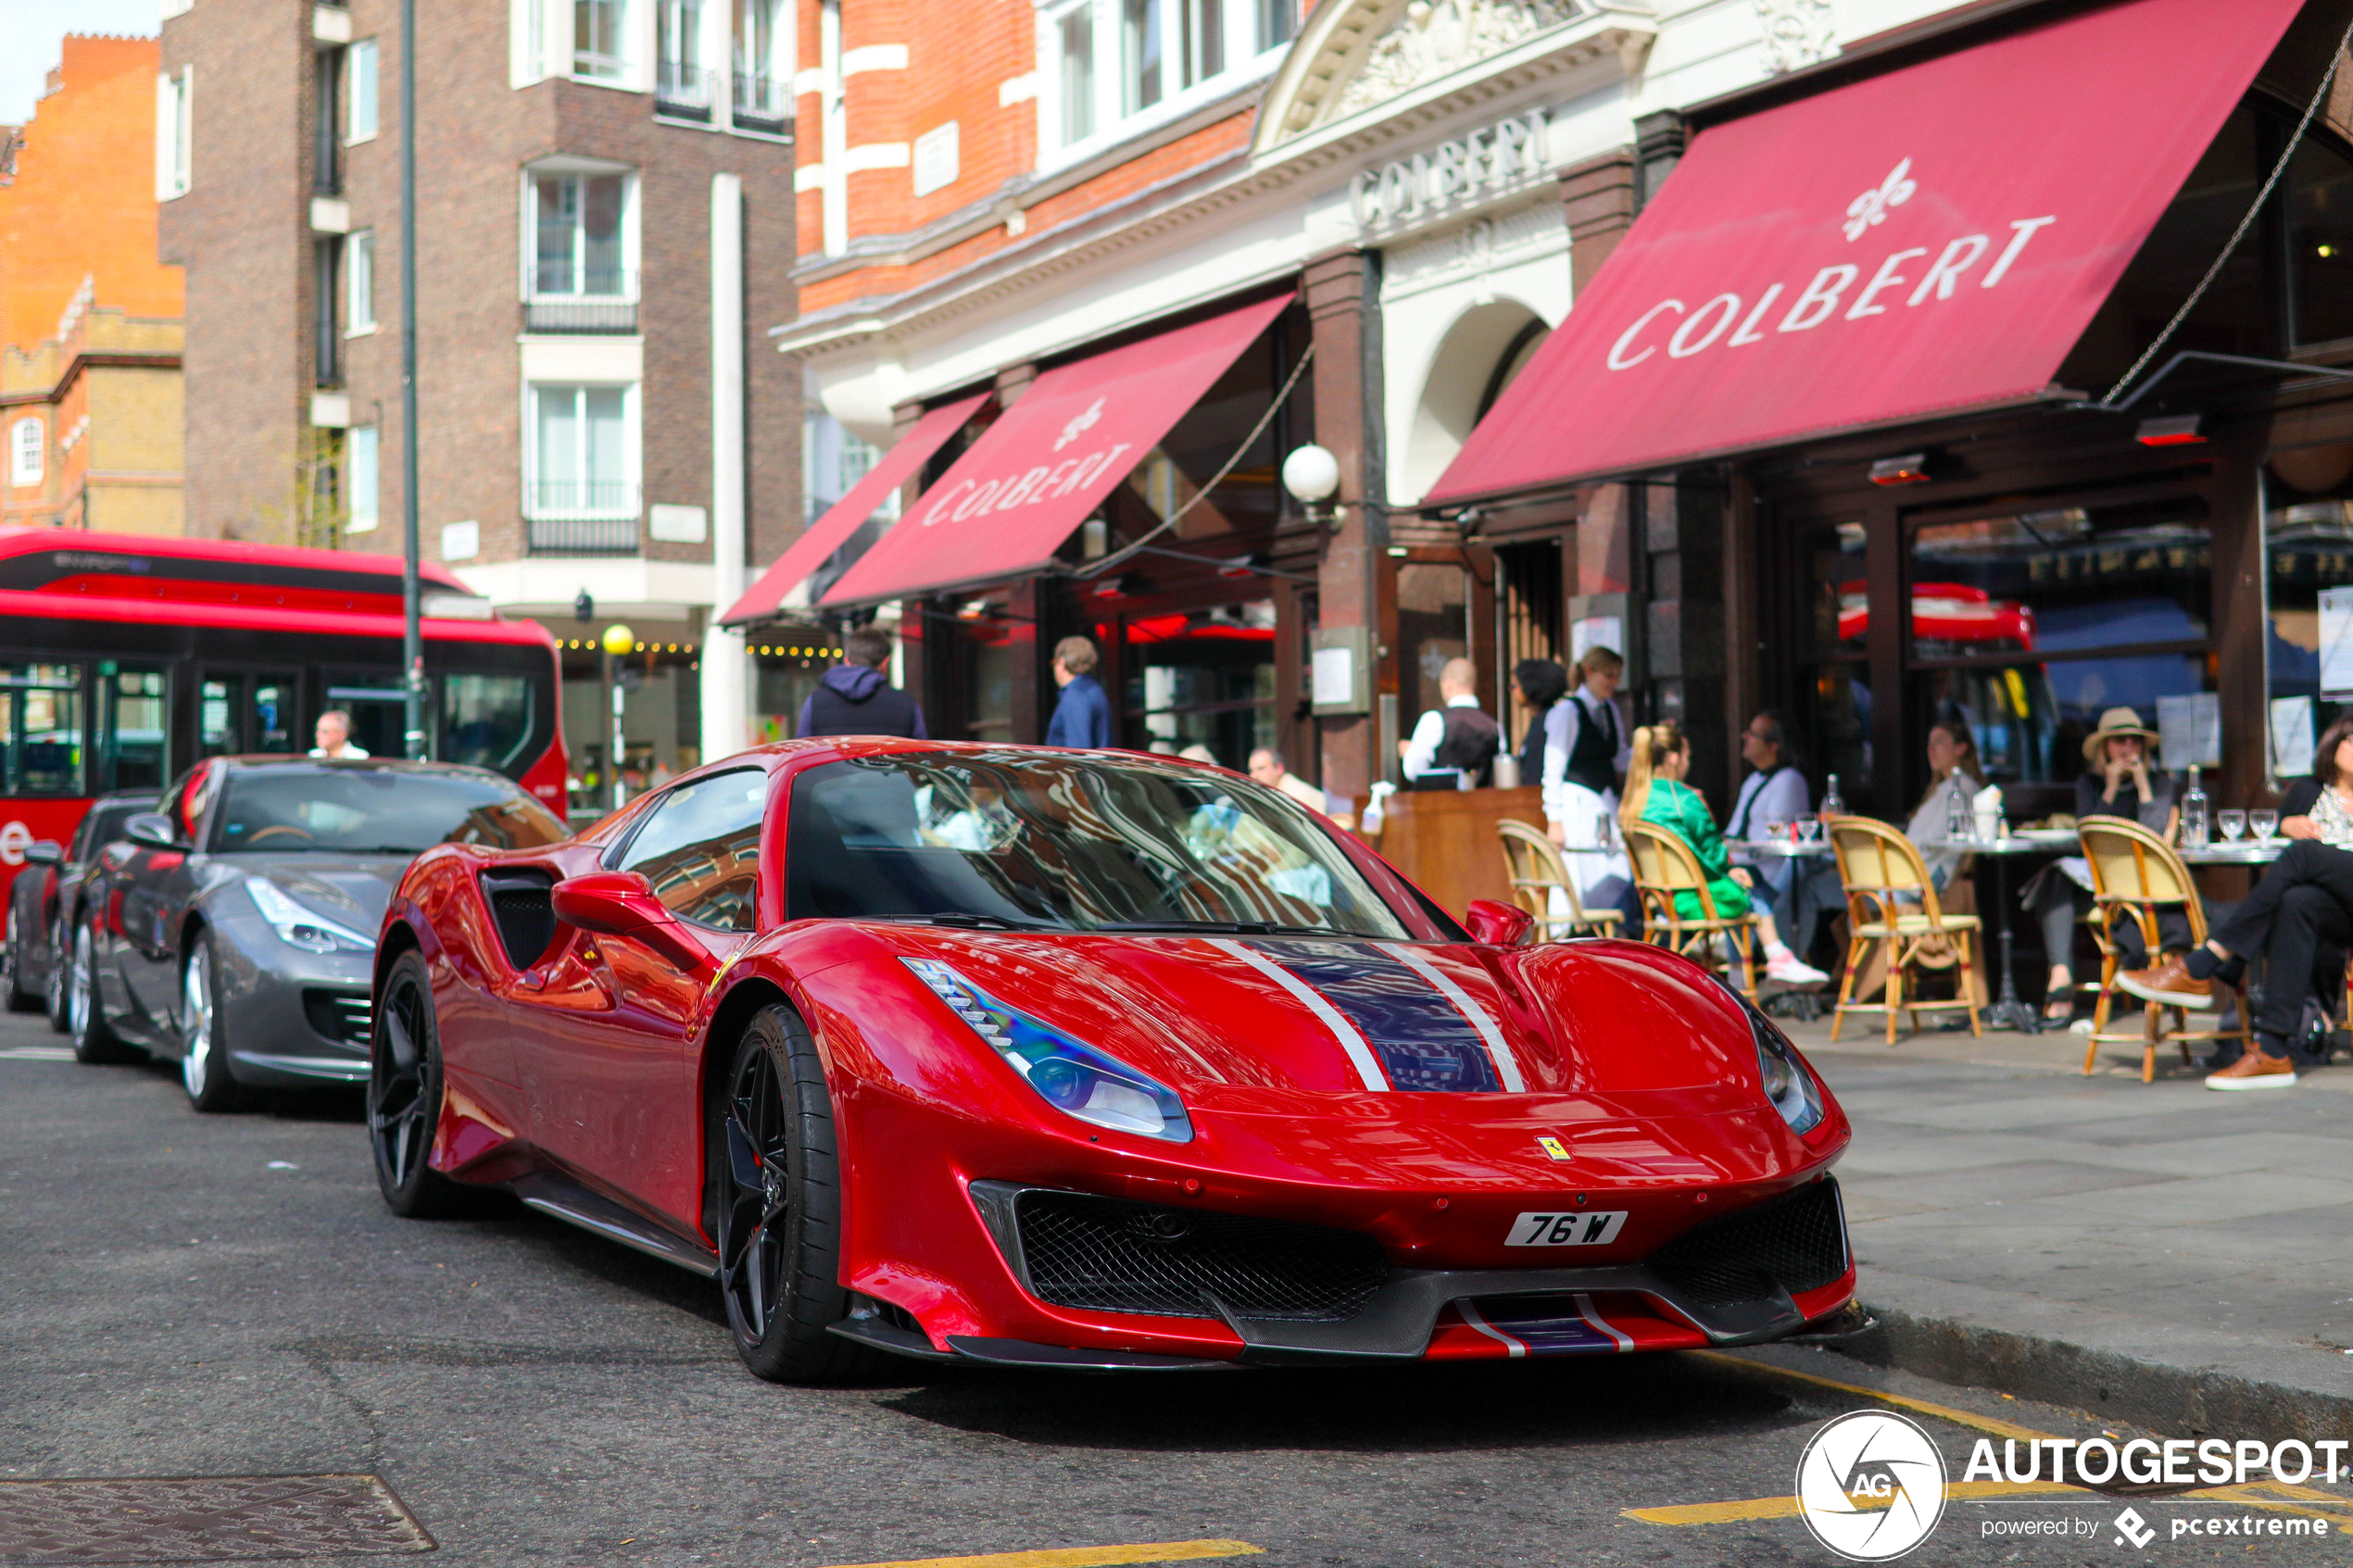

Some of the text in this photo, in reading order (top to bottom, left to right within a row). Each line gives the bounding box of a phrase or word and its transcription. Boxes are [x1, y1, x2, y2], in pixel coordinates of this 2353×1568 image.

[1348, 106, 1547, 232] COLBERT
[1606, 214, 2057, 371] COLBERT
[922, 443, 1132, 527] COLBERT
[1525, 1214, 1612, 1244] 76 W
